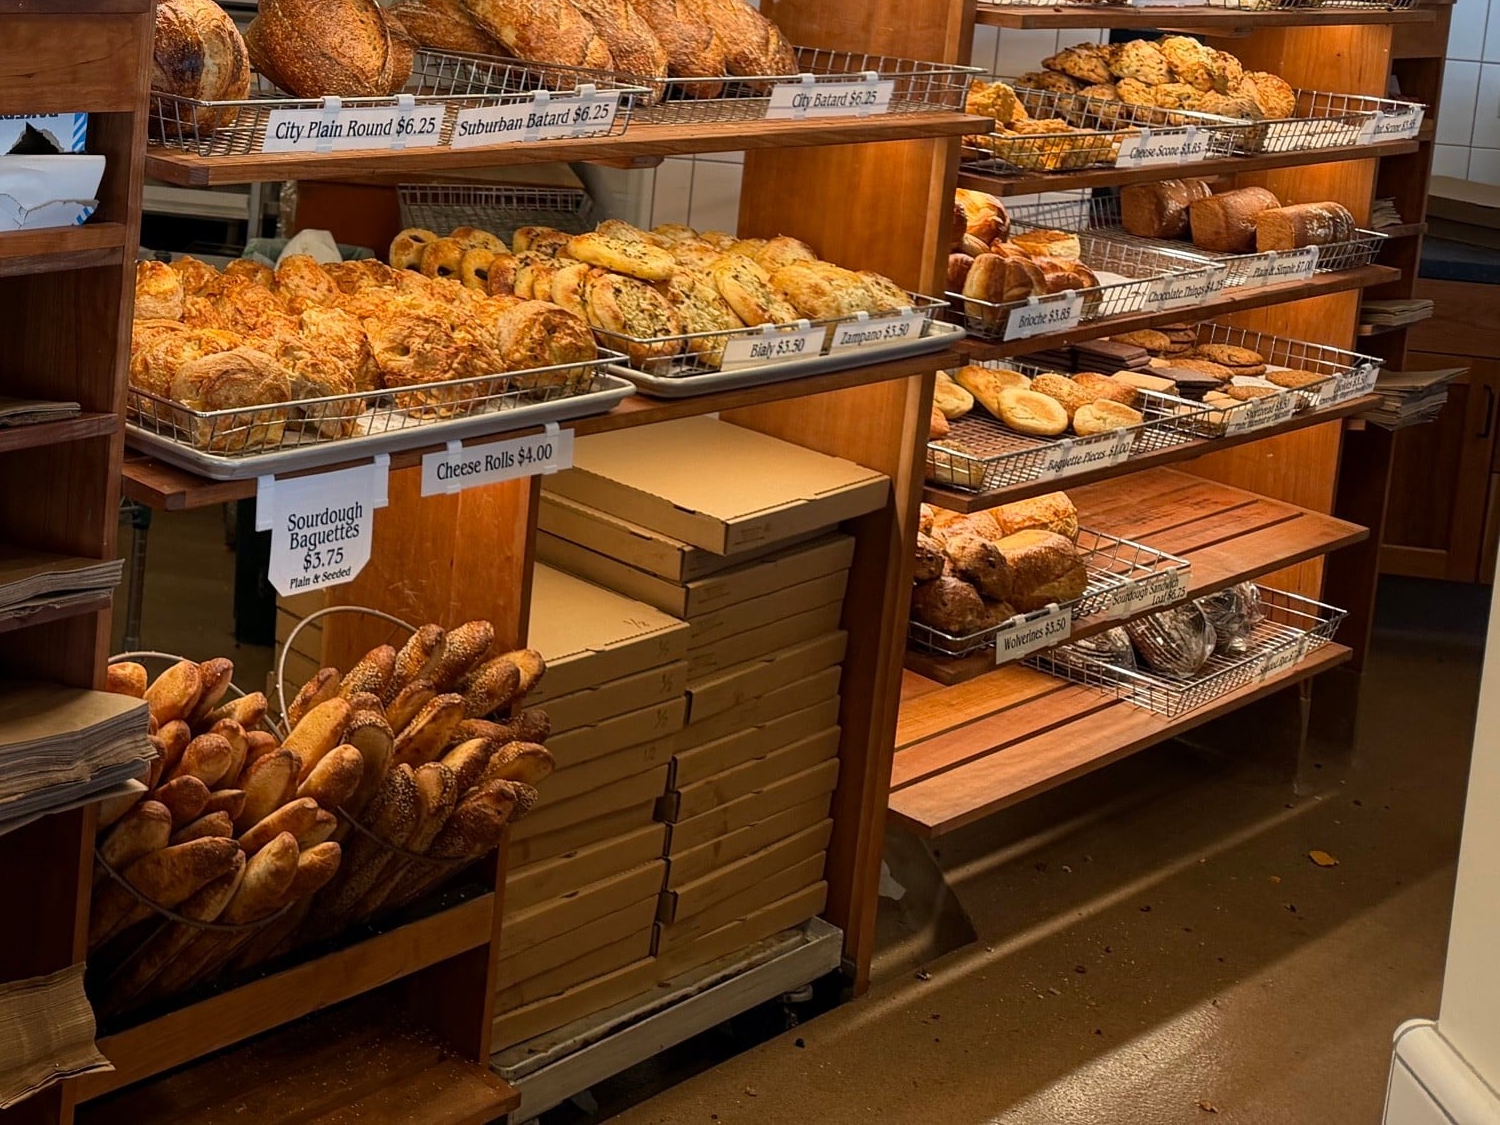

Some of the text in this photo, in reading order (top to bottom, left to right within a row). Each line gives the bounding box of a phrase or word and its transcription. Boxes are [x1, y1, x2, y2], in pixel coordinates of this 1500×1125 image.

[792, 90, 877, 111] City Batard $6.25
[275, 117, 436, 144] City Plain Round $6.25
[458, 103, 609, 137] Suburban Batard $6.25
[1148, 287, 1183, 302] Chocolate
[1019, 313, 1047, 328] Brioche
[839, 328, 882, 347] Zampano
[750, 343, 775, 359] Bialy
[436, 443, 553, 481] Cheese Rolls $4.00
[1047, 455, 1083, 472] Baguette
[1083, 449, 1106, 464] Pieces
[287, 501, 363, 532] Sourdough
[289, 522, 360, 553] Baguettes
[303, 547, 344, 572] $3.75
[290, 566, 351, 590] Plain & Seeded
[1112, 586, 1148, 606] Sourdough
[1152, 591, 1166, 605] Loaf
[1004, 628, 1043, 650] Wolverines
